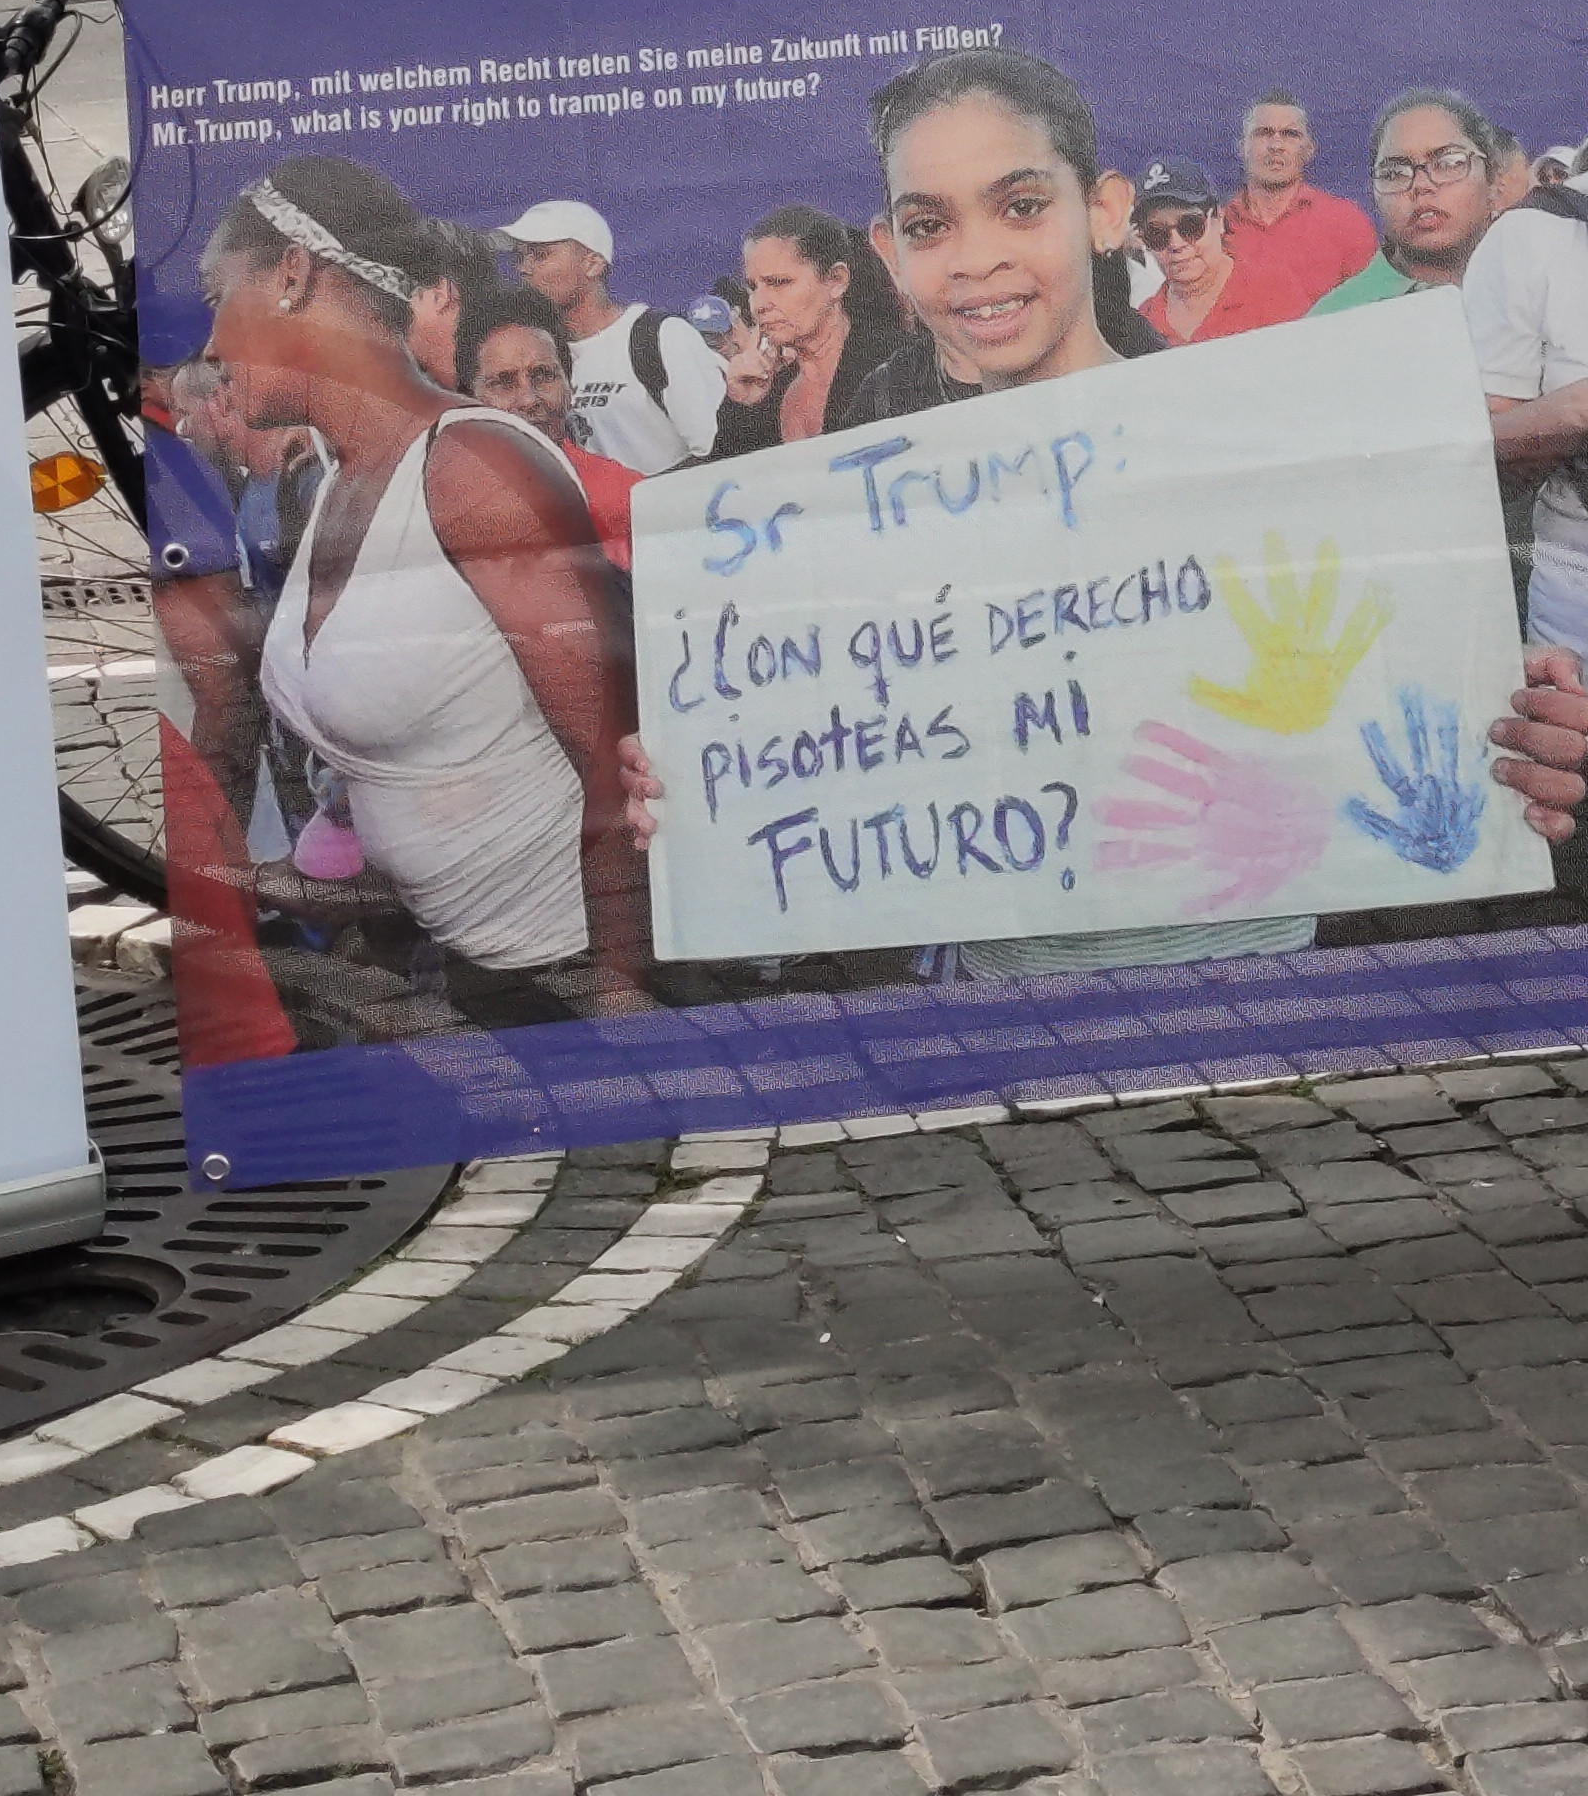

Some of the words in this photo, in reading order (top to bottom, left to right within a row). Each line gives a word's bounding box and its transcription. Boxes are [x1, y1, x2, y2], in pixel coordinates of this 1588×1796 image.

[150, 84, 206, 110] Herr
[212, 78, 301, 106] Trump,
[311, 70, 352, 98] mit
[359, 64, 472, 94] welchem
[480, 56, 552, 85] Recht
[559, 50, 630, 78] treten
[638, 48, 679, 73] Sie
[687, 43, 764, 70] meine
[770, 32, 862, 64] Zukunft
[868, 29, 909, 56] mit
[915, 22, 1005, 52] Füßen?
[152, 121, 194, 148] Mr.
[196, 116, 283, 146] Trump,
[291, 106, 352, 136] what
[360, 104, 382, 131] is
[389, 104, 445, 134] your
[452, 96, 511, 128] right
[517, 93, 542, 120] to
[549, 86, 645, 118] trample
[654, 86, 682, 109] on
[690, 81, 728, 109] my
[734, 72, 822, 104] future?
[701, 481, 807, 577] Sr
[989, 553, 1211, 659] DERECHO
[1013, 649, 1092, 751] MI
[746, 780, 1080, 915] FUTURO?
